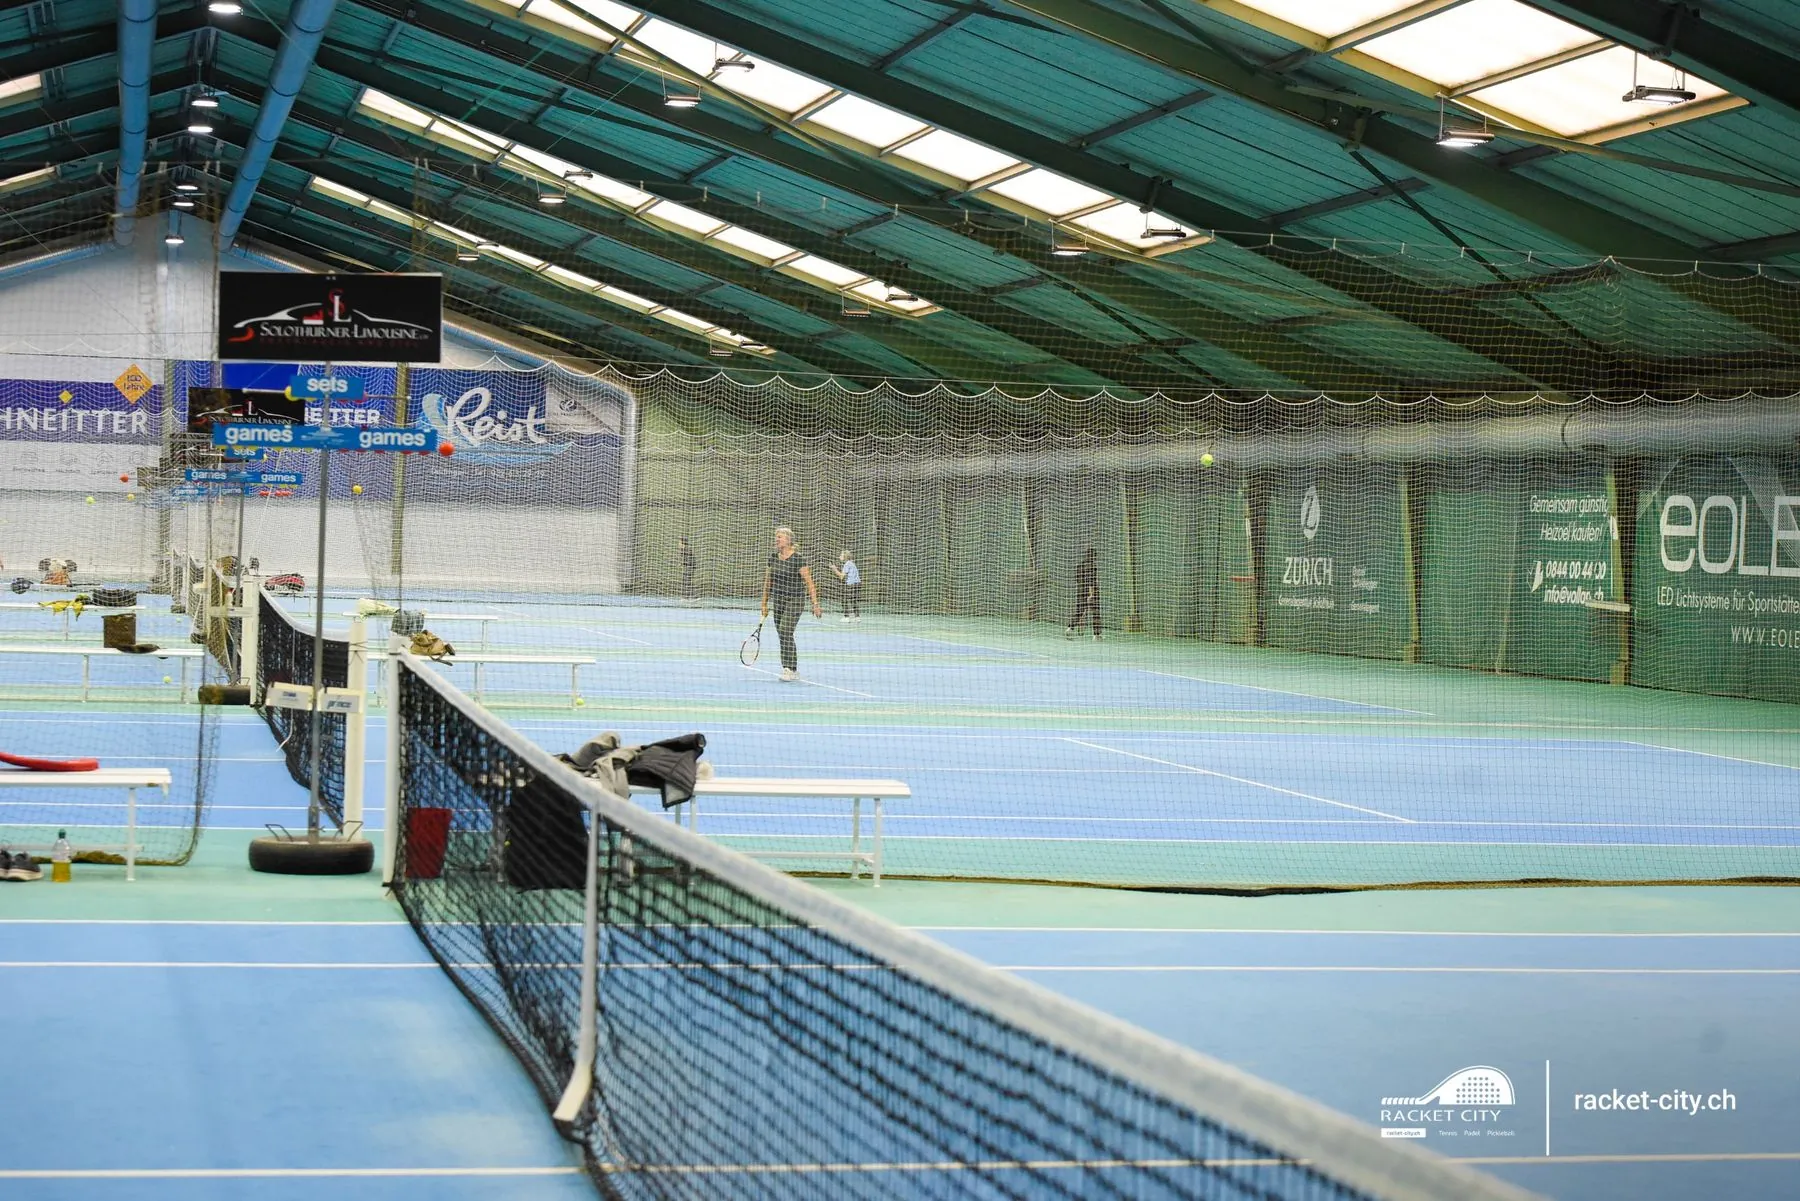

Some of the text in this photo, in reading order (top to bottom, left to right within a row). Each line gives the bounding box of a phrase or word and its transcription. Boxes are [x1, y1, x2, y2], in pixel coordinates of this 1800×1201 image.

[306, 375, 348, 393] sets
[444, 387, 547, 446] Reist
[225, 427, 293, 444] games
[359, 431, 426, 448] games
[191, 470, 227, 480] games
[261, 472, 296, 483] games
[1530, 495, 1577, 512] Gemeinsam
[1541, 522, 1571, 541] Heizoel
[1545, 561, 1568, 578] 0844
[1569, 562, 1580, 579] 00
[1581, 562, 1594, 579] 44
[1657, 586, 1674, 605] LED
[1676, 588, 1730, 613] Lichtsysteme
[1733, 589, 1745, 610] für
